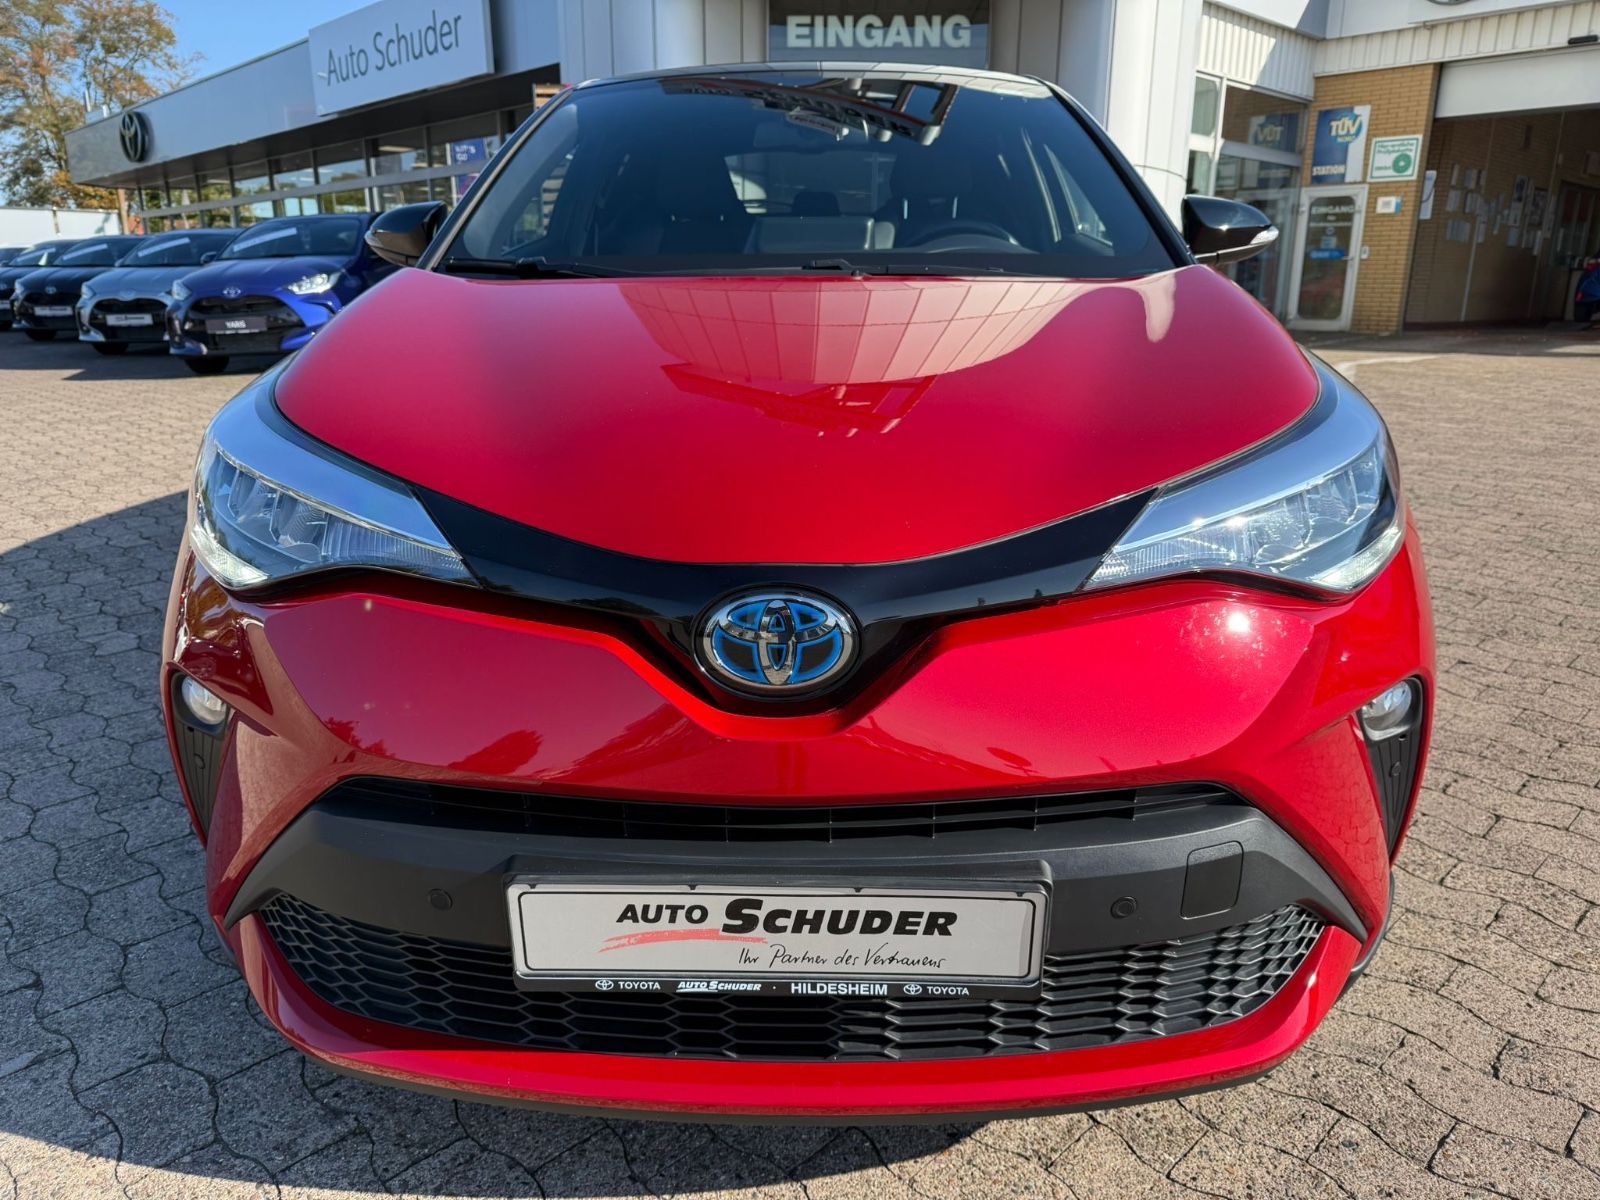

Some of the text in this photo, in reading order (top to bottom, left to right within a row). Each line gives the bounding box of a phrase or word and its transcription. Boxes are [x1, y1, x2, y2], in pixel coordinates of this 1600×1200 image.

[786, 14, 971, 48] EINGANG
[327, 9, 461, 87] Auto Schuder
[1330, 115, 1361, 136] TÜV
[616, 898, 957, 936] AUTO SCHUDER
[738, 942, 946, 968] Ihr Partner des Vertrauens
[618, 981, 661, 990] TOYOTA
[791, 982, 888, 995] HILDESHEIM
[927, 986, 969, 995] TOYOTA
